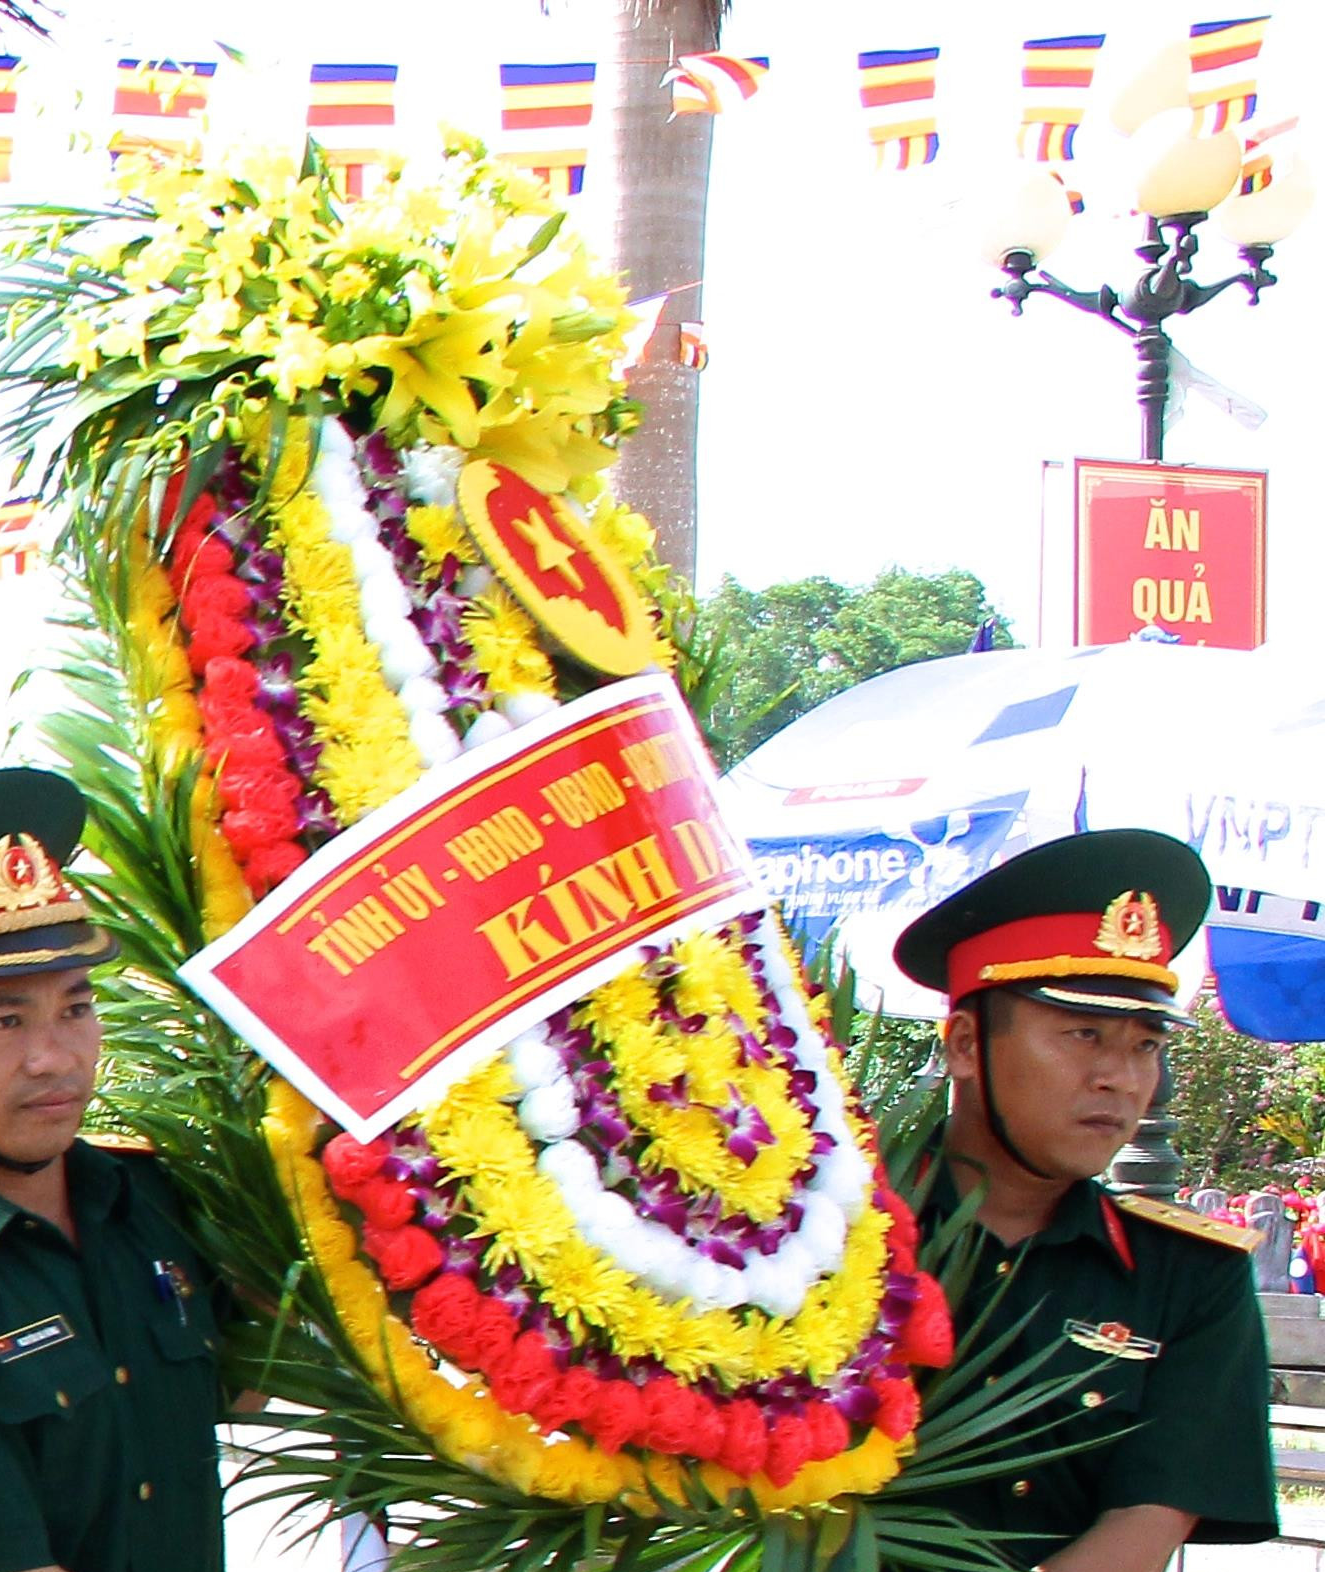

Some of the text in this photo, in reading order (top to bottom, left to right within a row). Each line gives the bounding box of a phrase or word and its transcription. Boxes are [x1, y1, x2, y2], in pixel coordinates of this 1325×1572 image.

[1143, 498, 1201, 552] ĂN
[1132, 563, 1213, 626] QUẢ
[1186, 793, 1325, 868] VNPT
[305, 910, 407, 976] TỈNH
[373, 863, 446, 921] ỦY
[539, 761, 627, 829] UBND
[750, 843, 907, 895] aphone
[474, 834, 683, 983] KÍNH
